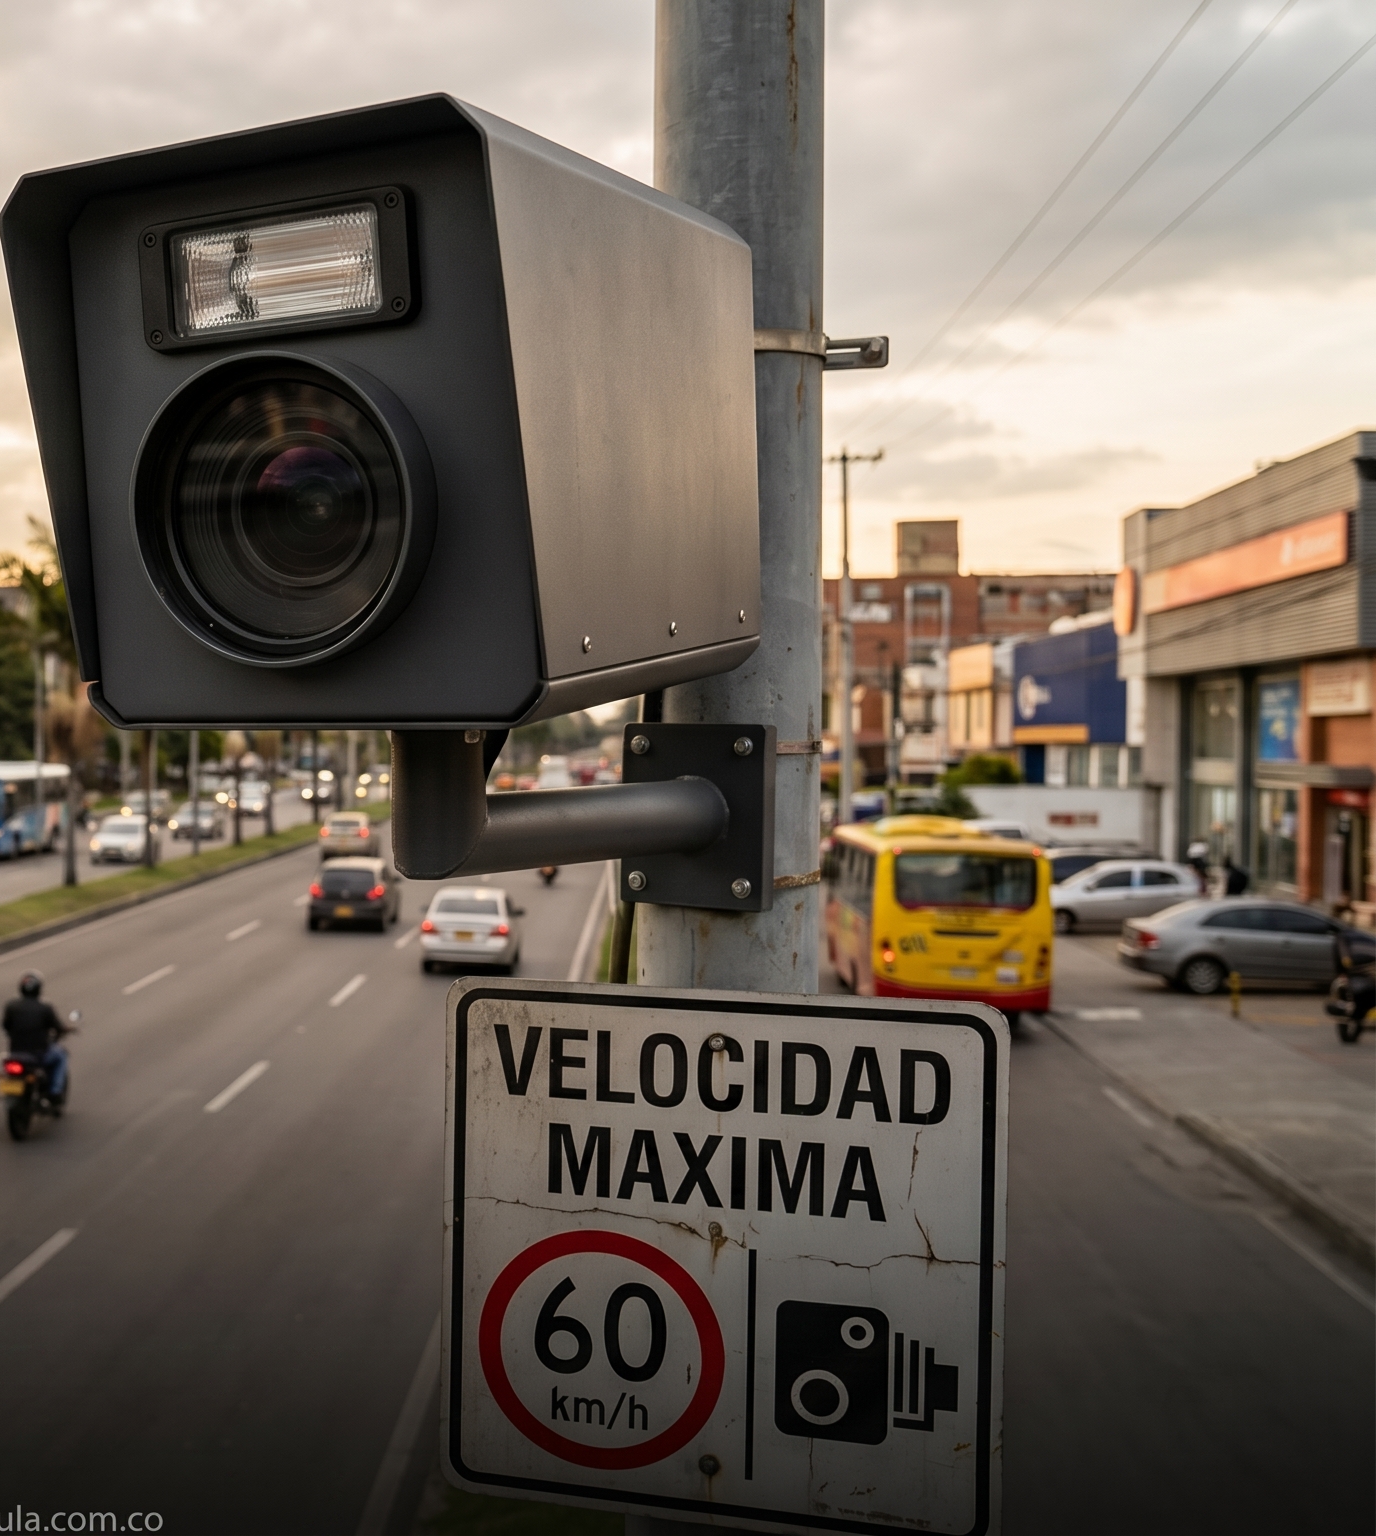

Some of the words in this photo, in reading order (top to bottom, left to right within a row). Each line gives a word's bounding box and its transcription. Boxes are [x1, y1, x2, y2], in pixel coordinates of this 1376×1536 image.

[494, 1024, 951, 1125] VELOCIDAD
[547, 1123, 887, 1223] MAXIMA
[534, 1276, 667, 1383] 60
[550, 1386, 649, 1431] km/h
